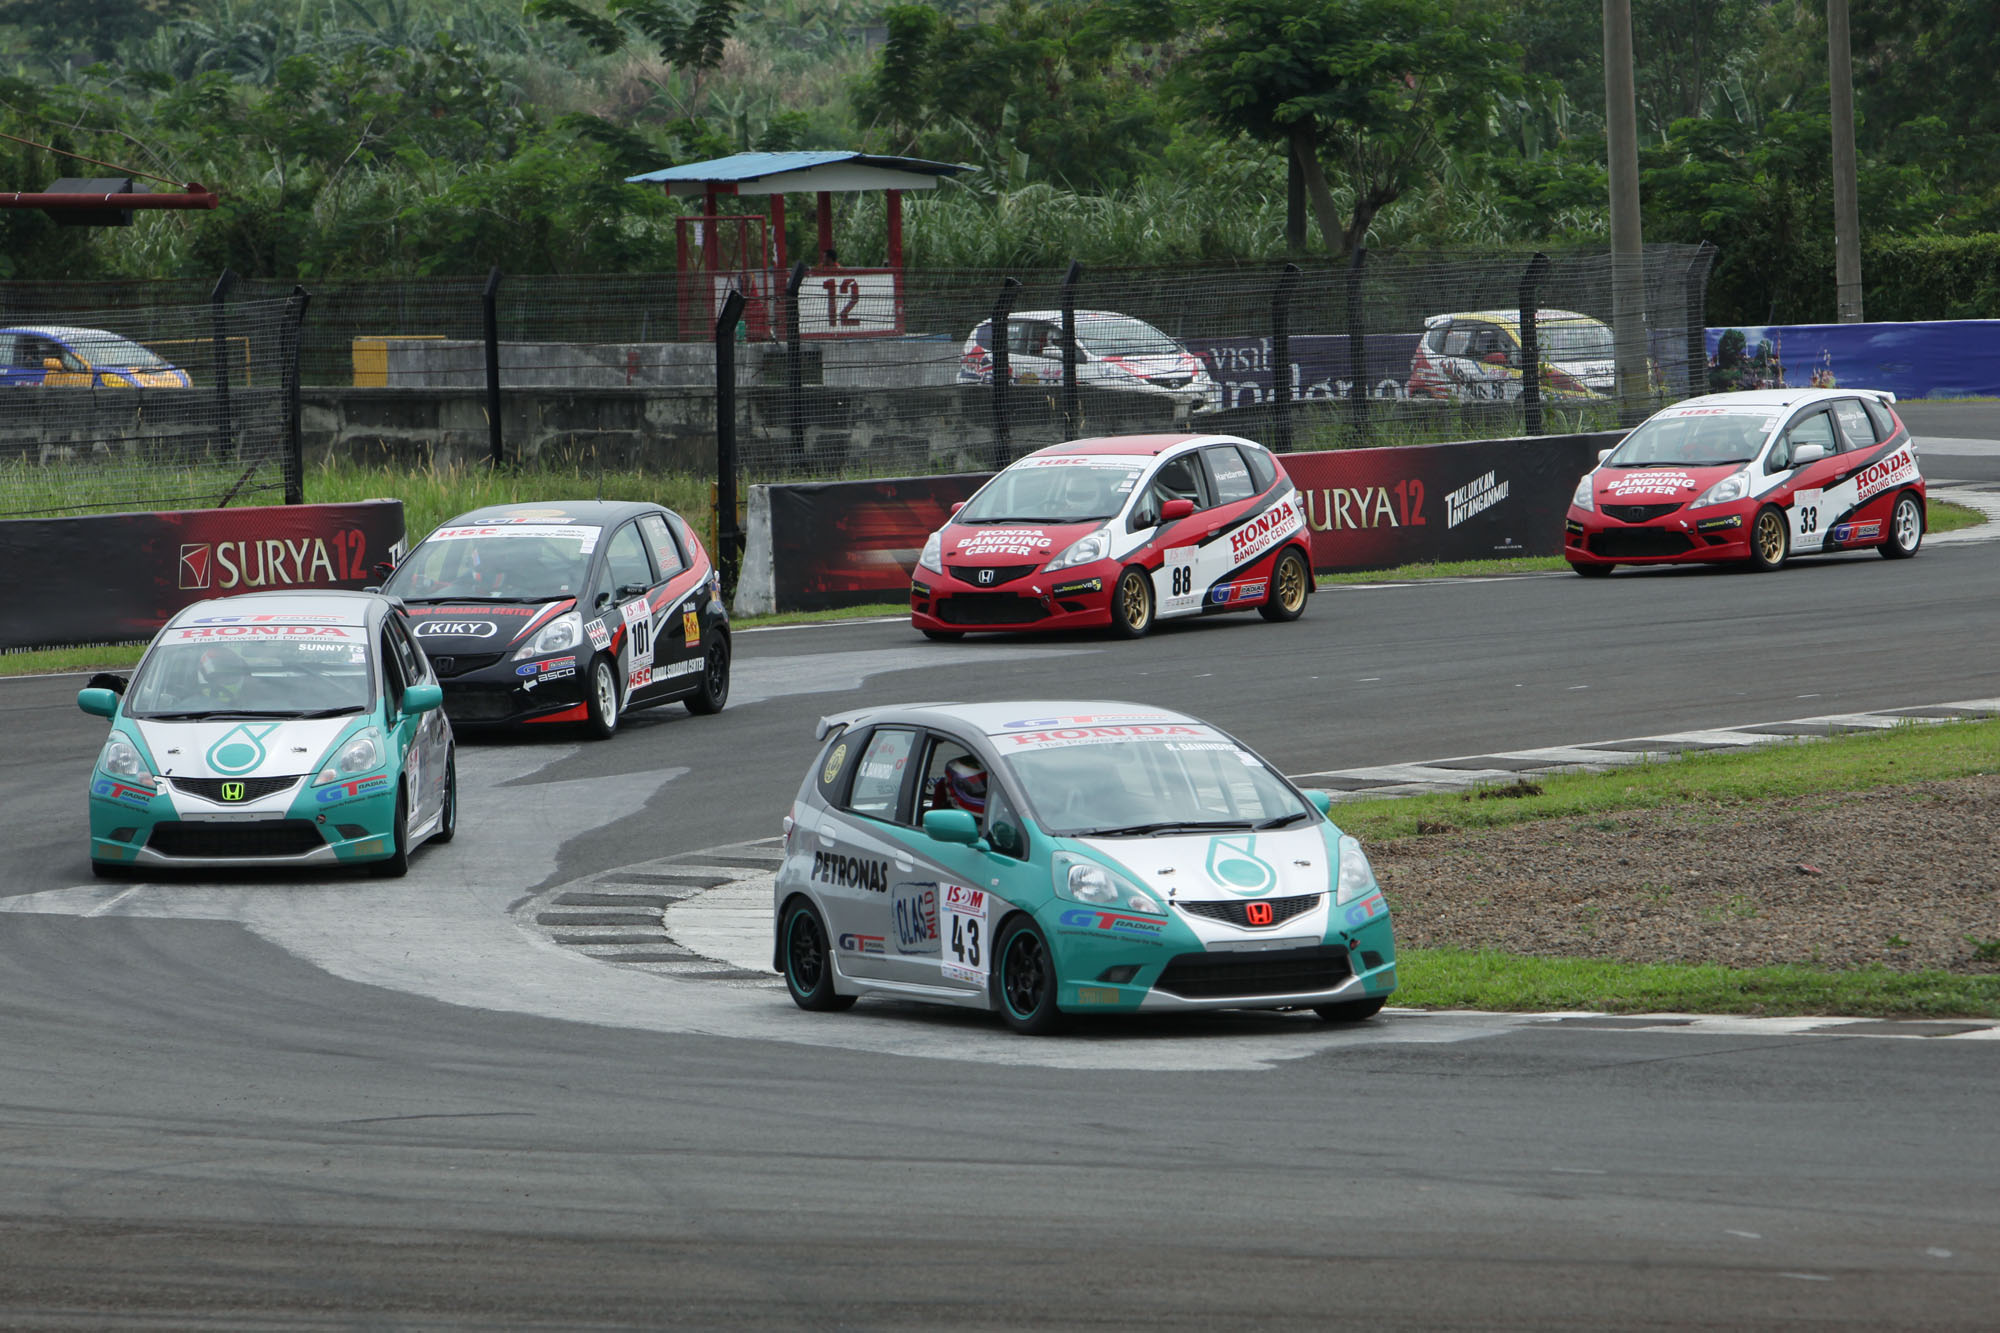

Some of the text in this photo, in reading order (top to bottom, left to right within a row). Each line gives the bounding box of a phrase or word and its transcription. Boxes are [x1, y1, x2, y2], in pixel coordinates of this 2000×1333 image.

[823, 278, 861, 328] 12
[1210, 338, 1272, 372] visit
[1214, 469, 1248, 481] Haridarma
[1607, 478, 1696, 489] BANDUNG
[1855, 450, 1911, 491] HONDA
[1857, 464, 1912, 502] BANDUNG CENTER
[1394, 479, 1426, 526] 12
[1445, 470, 1495, 510] TAKLUKKAN
[1447, 480, 1509, 529] TANTANGANMU!
[1615, 486, 1677, 496] CENTER
[438, 528, 498, 538] HSC
[975, 529, 1044, 537] HONDA
[1230, 501, 1294, 553] HONDA
[1800, 506, 1817, 534] 33
[956, 536, 1052, 548] BANDUNG
[965, 545, 1031, 556] CENTER
[1233, 516, 1297, 565] BANDUNG CENTER
[216, 538, 337, 589] SURYA
[332, 529, 368, 580] 12
[1172, 565, 1191, 597] 88
[492, 608, 535, 617] CENTER
[179, 626, 351, 639] HONDA
[428, 623, 482, 633] KIKY
[631, 619, 650, 657] 101
[298, 643, 364, 654] SUNNY TS
[628, 666, 651, 688] HSC
[688, 656, 705, 673] CENTER
[1007, 725, 1206, 746] HONDA
[811, 850, 888, 893] PETRONAS
[895, 894, 927, 946] CLAS
[924, 890, 939, 940] MILD
[1345, 893, 1379, 925] GT
[951, 914, 981, 967] 43
[1115, 920, 1163, 932] RADIAL
[839, 933, 867, 953] GT
